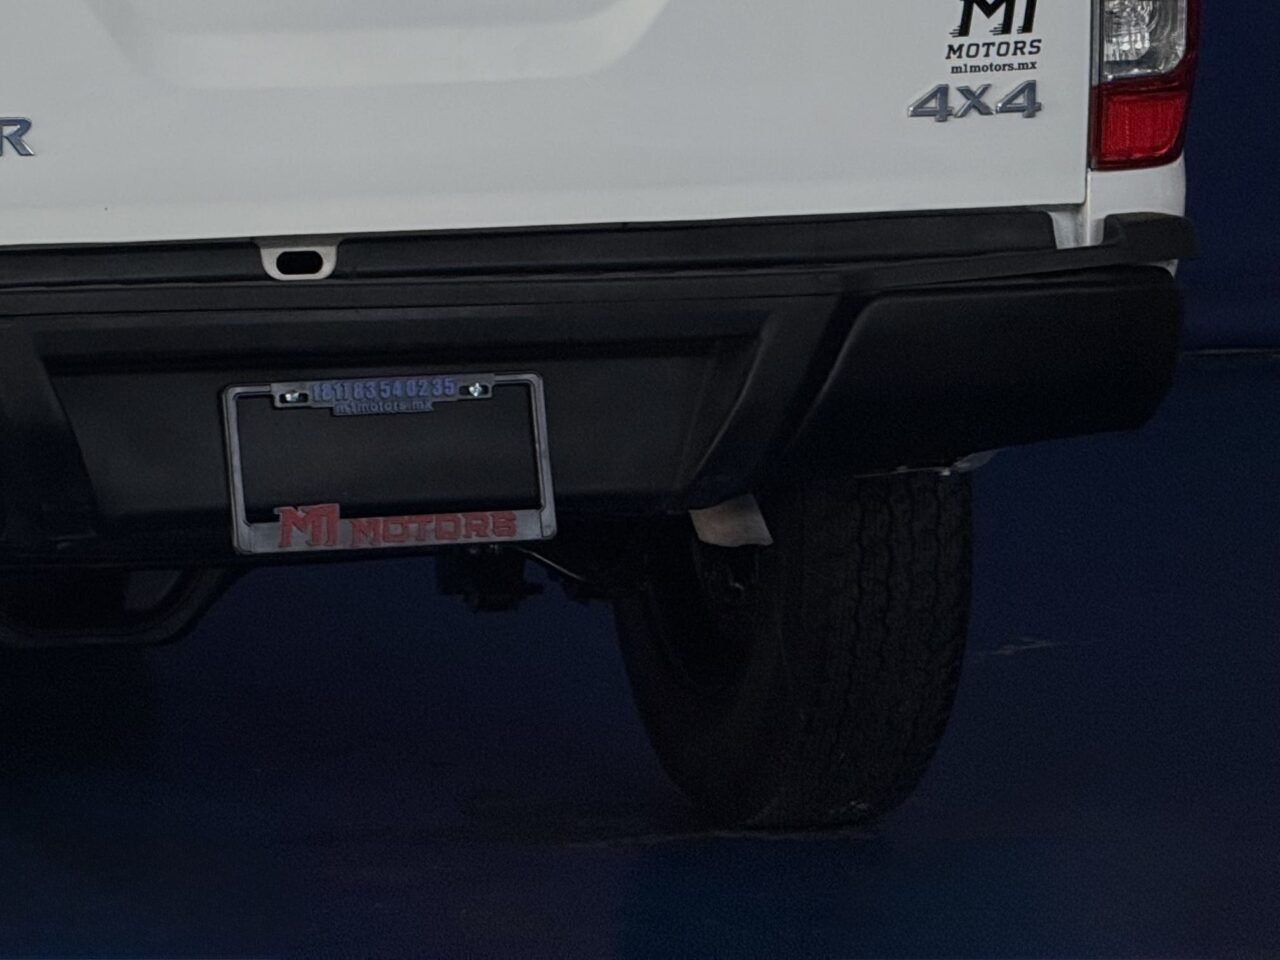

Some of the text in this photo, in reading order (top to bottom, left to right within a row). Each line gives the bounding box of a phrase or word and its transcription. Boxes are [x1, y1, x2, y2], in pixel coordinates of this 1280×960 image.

[945, 39, 1042, 60] MOTORS
[950, 61, 1037, 74] m1motors.mx
[275, 505, 518, 548] M1 MOTORS
